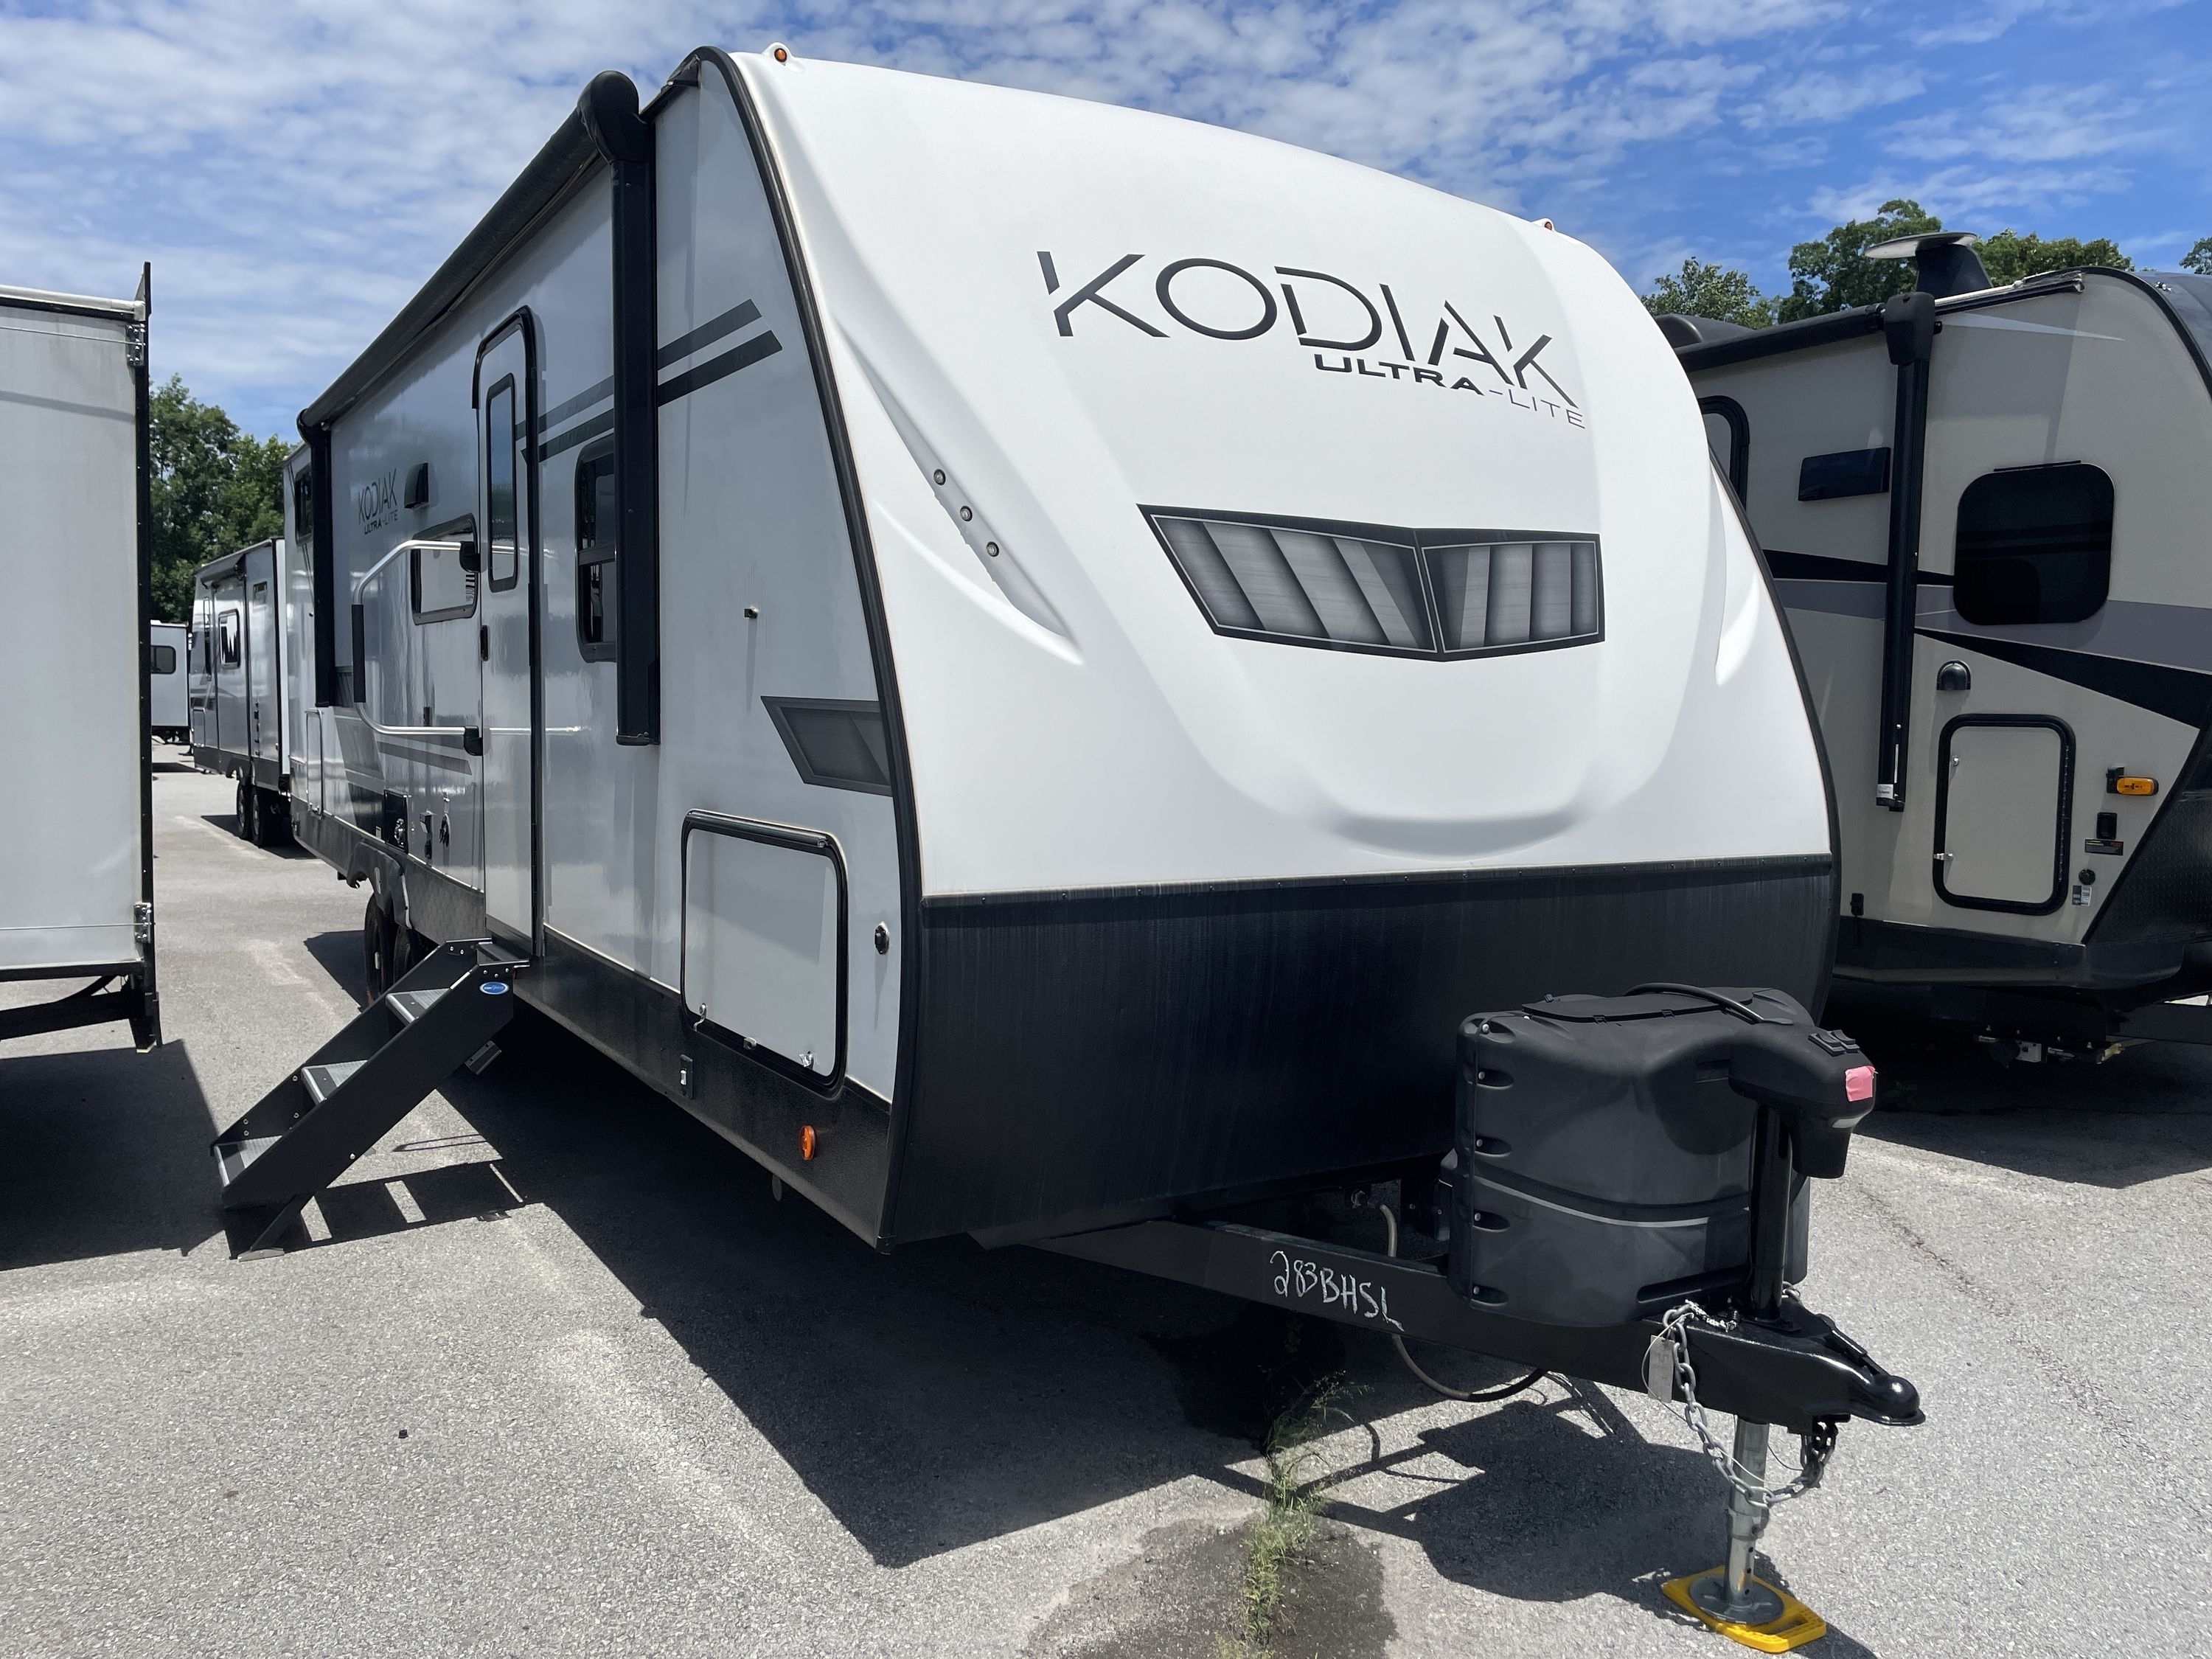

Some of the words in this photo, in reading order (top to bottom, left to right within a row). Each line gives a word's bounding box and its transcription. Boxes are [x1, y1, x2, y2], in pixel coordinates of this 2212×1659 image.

[1036, 251, 1579, 408] KODIAK
[1314, 353, 1585, 428] ULTRA-LITE
[358, 468, 397, 524] KODIAK
[364, 509, 398, 535] ULTRA-LITE
[1270, 1251, 1405, 1332] 283BHSL
